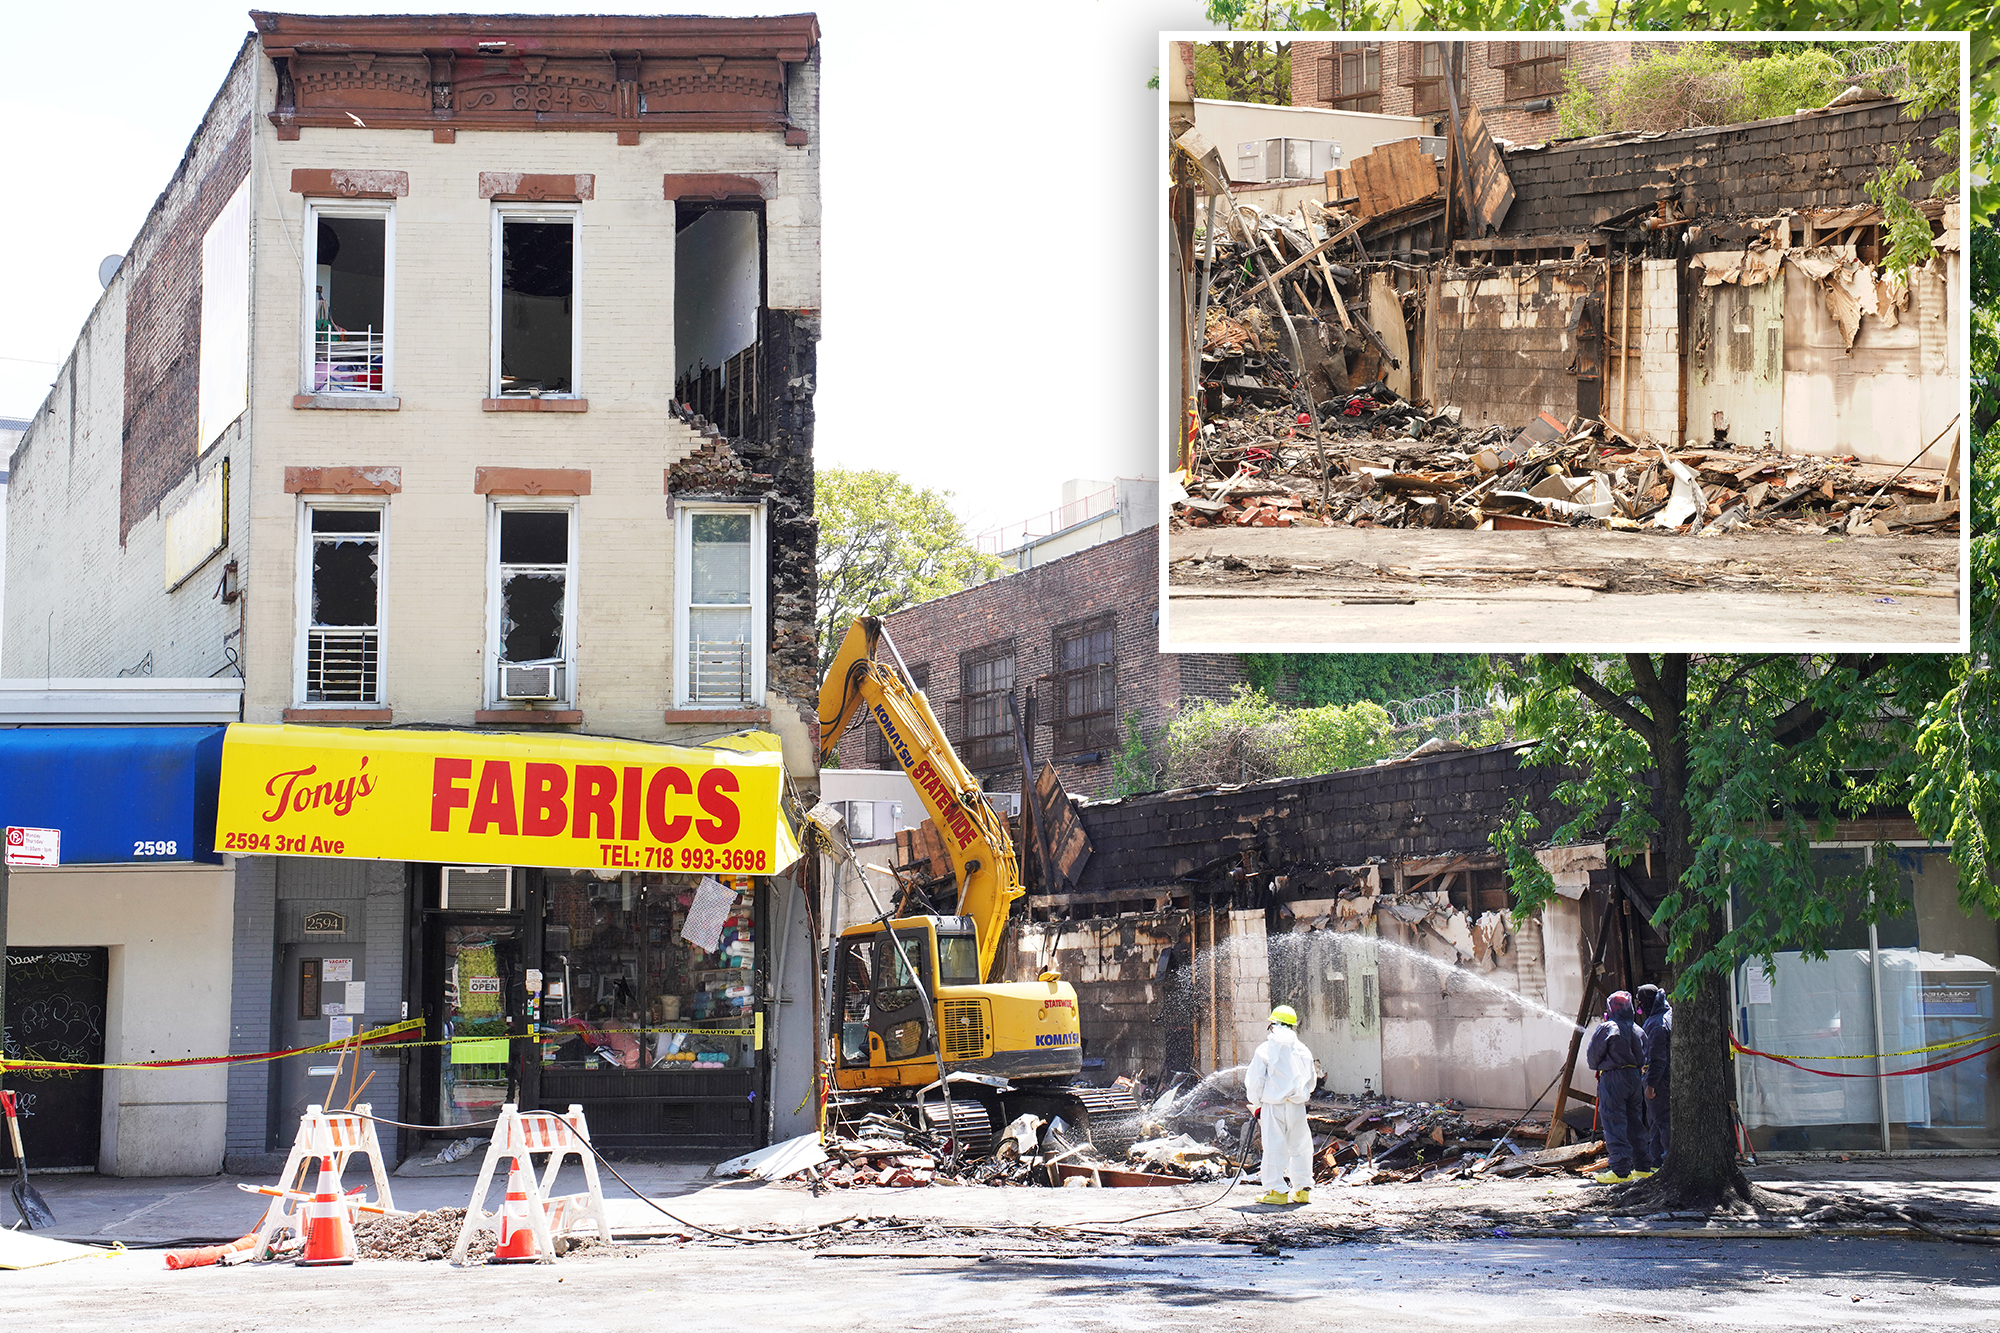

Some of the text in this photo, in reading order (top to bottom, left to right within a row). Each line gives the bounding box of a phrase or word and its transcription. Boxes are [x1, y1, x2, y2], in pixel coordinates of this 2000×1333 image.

[873, 703, 915, 769] KOMATSU
[262, 755, 378, 823] Tony's
[430, 757, 741, 845] FABRICS
[911, 760, 978, 850] STATEWIDE
[133, 840, 177, 856] 2598
[225, 832, 345, 854] 2594 3rd Ave
[600, 844, 766, 871] TEL: 718 993-3698
[307, 917, 338, 930] 2594
[471, 983, 498, 991] OPEN
[1044, 999, 1073, 1009] STATEWIDE
